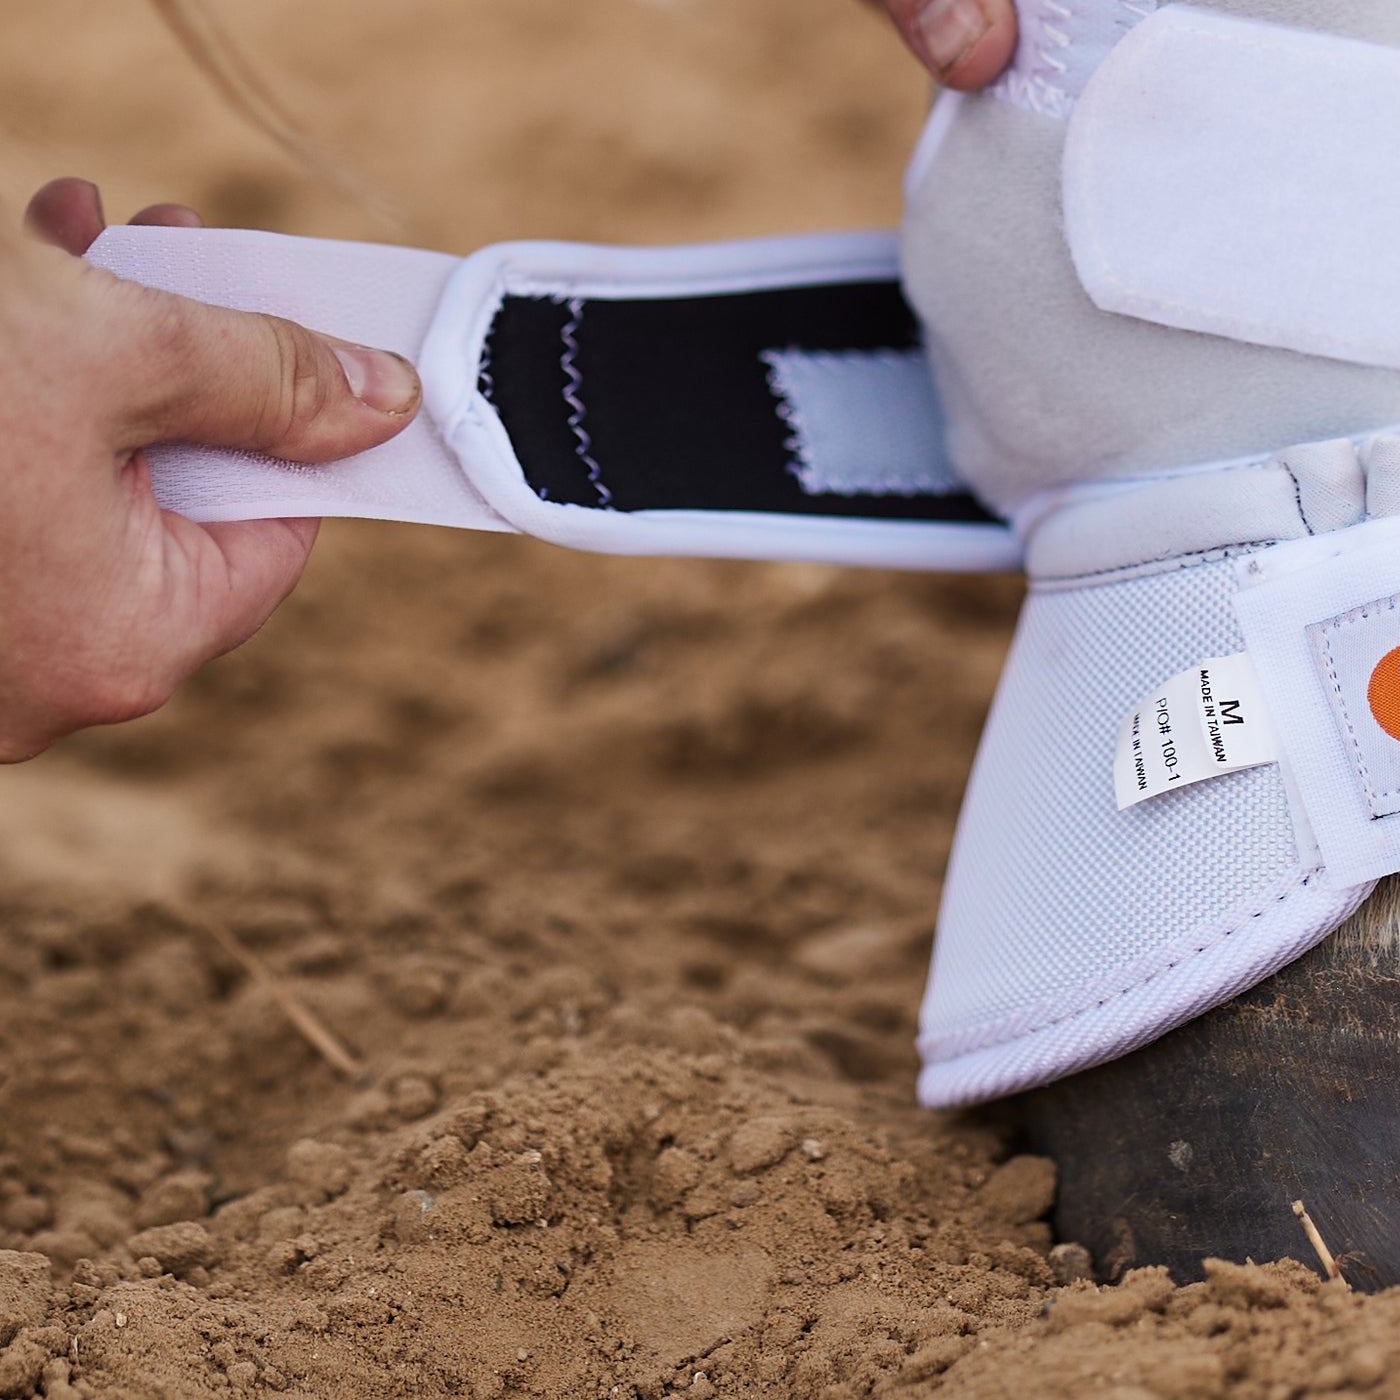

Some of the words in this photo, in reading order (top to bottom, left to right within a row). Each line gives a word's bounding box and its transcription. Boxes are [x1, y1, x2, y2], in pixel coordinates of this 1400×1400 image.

[1200, 669, 1213, 703] MADE
[1204, 705, 1216, 718] IN
[1219, 699, 1245, 725] M
[1207, 719, 1227, 763] TAIWAN
[1161, 738, 1182, 782] 100-1
